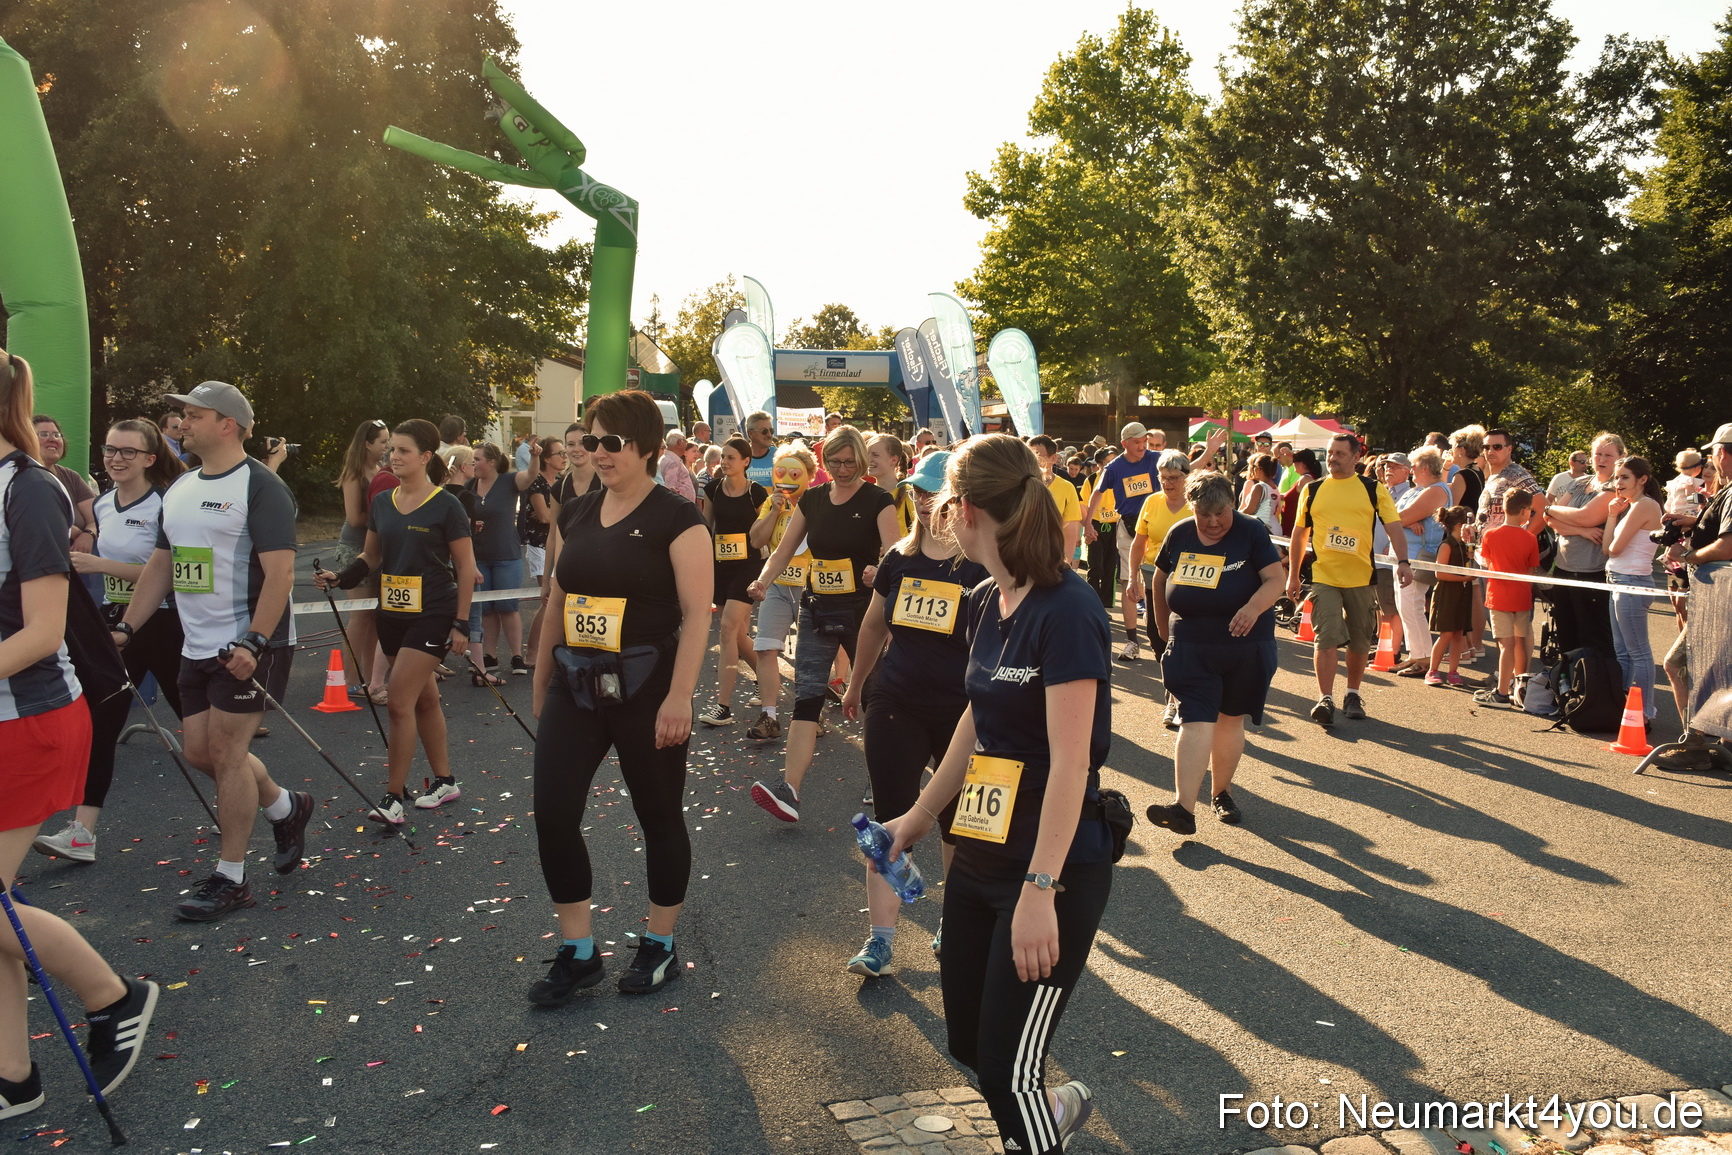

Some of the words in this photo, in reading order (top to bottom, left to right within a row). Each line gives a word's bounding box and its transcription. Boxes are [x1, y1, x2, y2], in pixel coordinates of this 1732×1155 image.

[819, 368, 862, 378] firmenlauf
[1127, 480, 1148, 491] 1096
[201, 501, 222, 509] swn
[1329, 534, 1356, 547] 1636
[720, 543, 738, 554] 851
[172, 562, 202, 580] 911
[1181, 564, 1215, 579] 1110
[818, 571, 844, 585] 854
[387, 587, 411, 601] 296
[904, 595, 948, 618] 1113
[575, 613, 607, 635] 853
[967, 814, 989, 825] Gabriela
